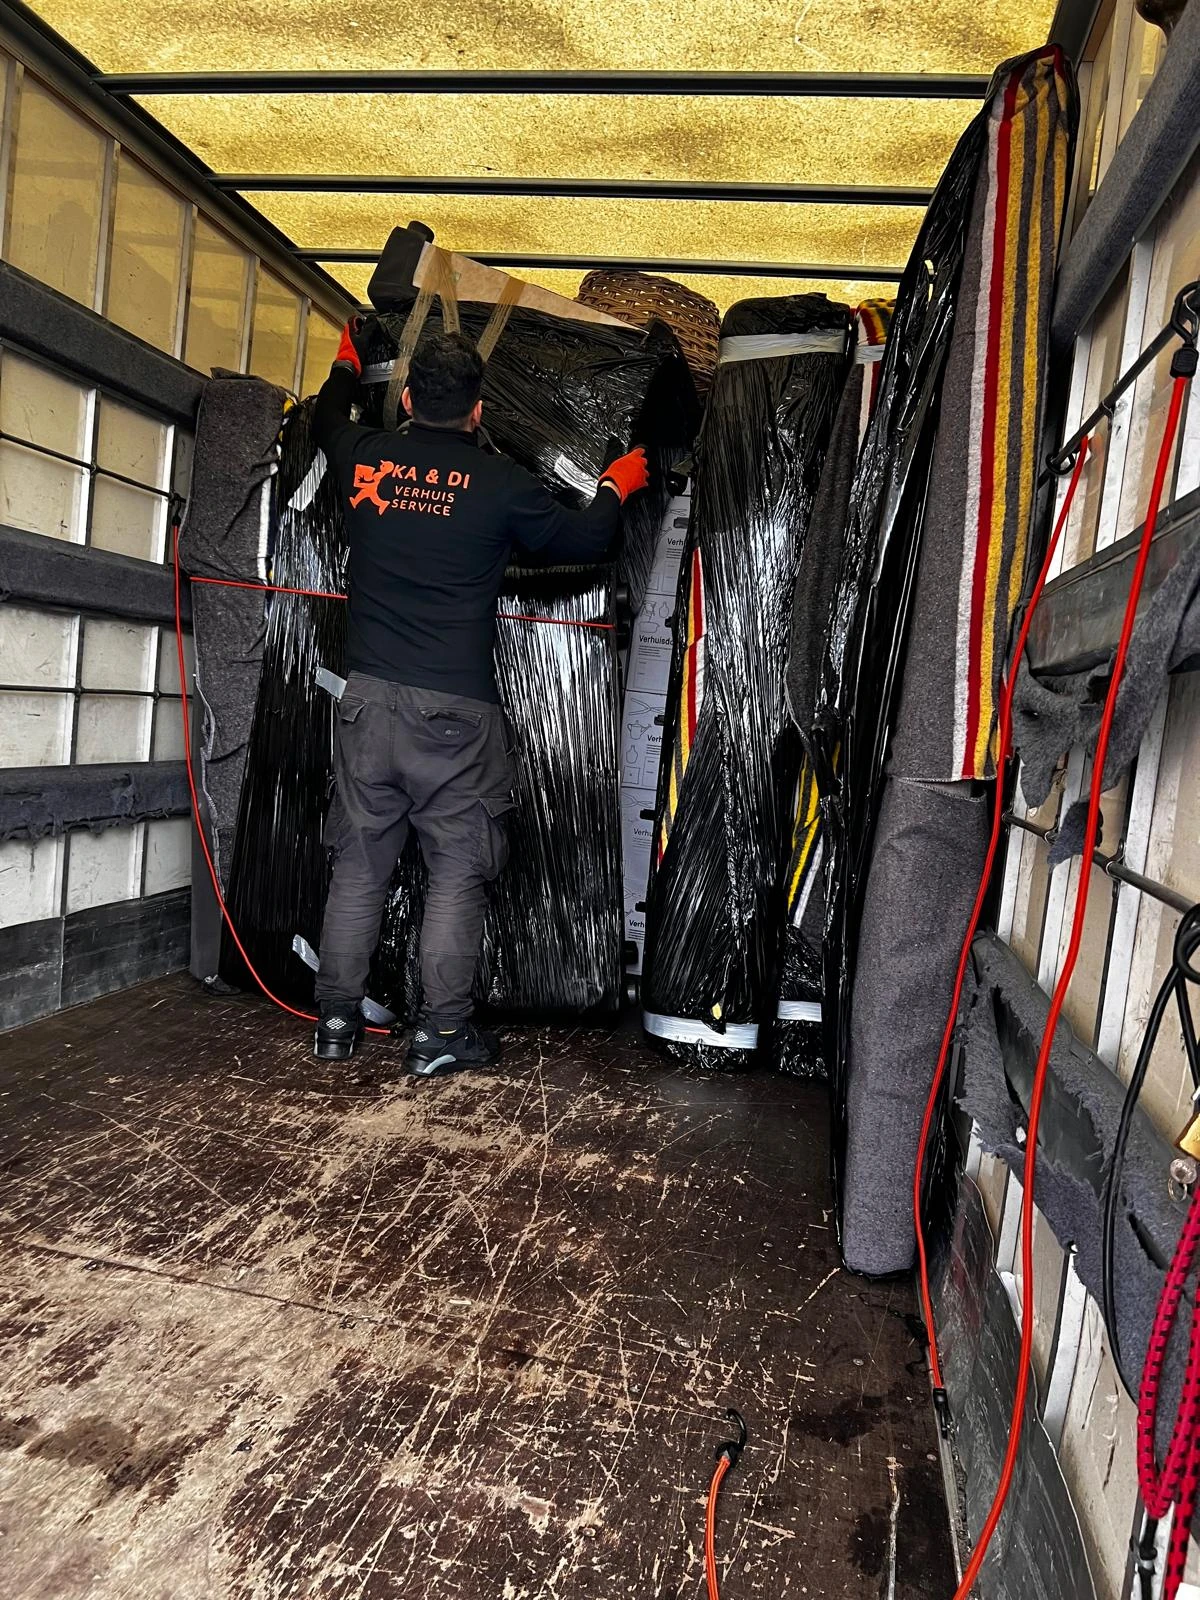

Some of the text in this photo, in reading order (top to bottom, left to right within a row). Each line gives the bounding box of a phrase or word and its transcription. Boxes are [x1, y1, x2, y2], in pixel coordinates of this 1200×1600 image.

[391, 464, 470, 489] KA & DI
[395, 485, 455, 503] VERHUIS
[391, 499, 452, 516] SERVICE
